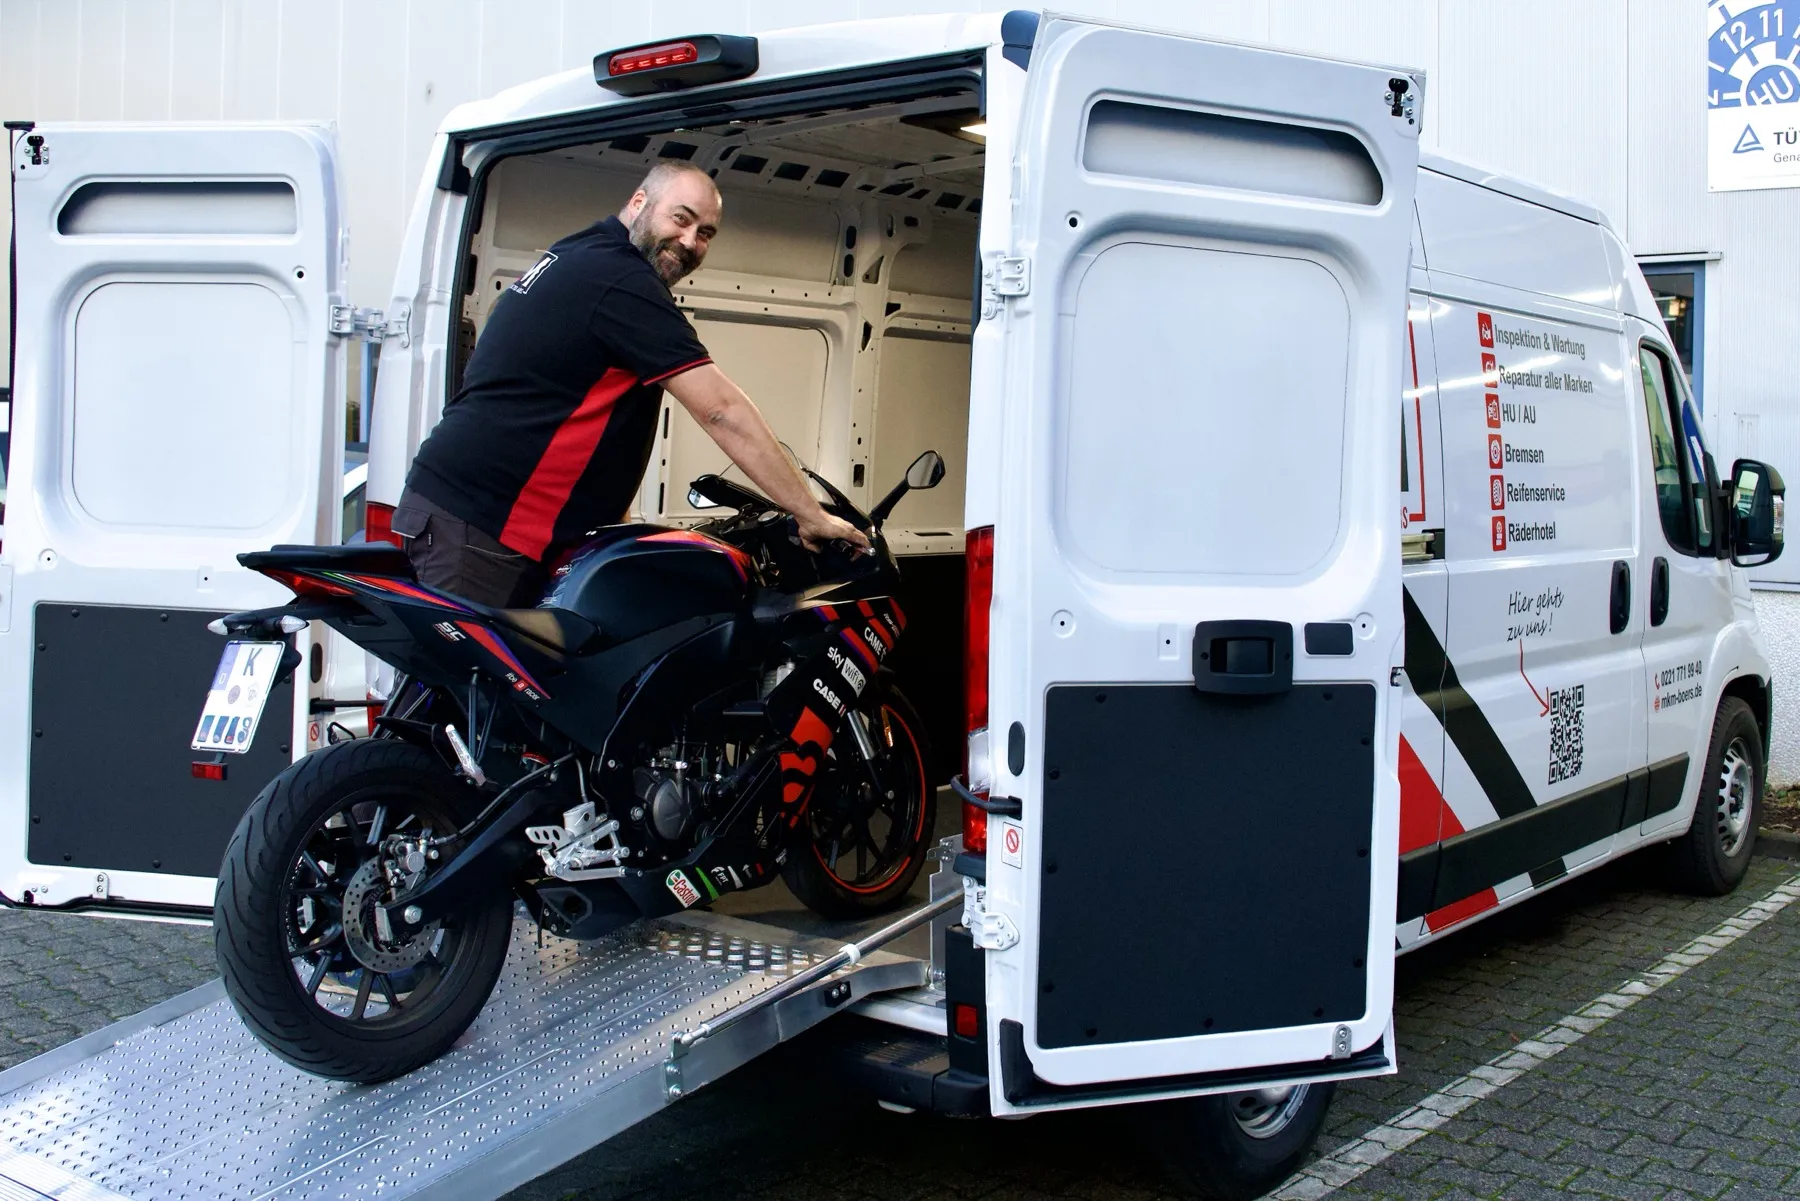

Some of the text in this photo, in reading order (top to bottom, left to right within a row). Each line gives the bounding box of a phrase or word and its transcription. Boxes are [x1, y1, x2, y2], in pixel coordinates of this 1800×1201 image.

[1759, 8, 1783, 38] 11
[1720, 21, 1755, 55] 12
[1749, 70, 1794, 105] HU
[1773, 127, 1800, 145] TÜ
[1494, 324, 1586, 360] Inspektion & Wartung
[1498, 365, 1593, 393] Reparatur aller Marken
[1502, 403, 1516, 422] HU
[1523, 405, 1536, 424] AU
[1505, 444, 1544, 463] Bremsen
[1507, 483, 1565, 502] Reifenservice
[1508, 522, 1556, 542] Räderhotel
[1508, 586, 1564, 616] Hier gehts
[1506, 625, 1524, 642] zu
[243, 647, 262, 676] K
[827, 646, 860, 685] sky wifi
[1661, 660, 1702, 686] 0221 771 99 40
[813, 678, 841, 710] CASE
[1661, 682, 1702, 709] mkm-boers.de
[673, 879, 700, 906] Castrol
